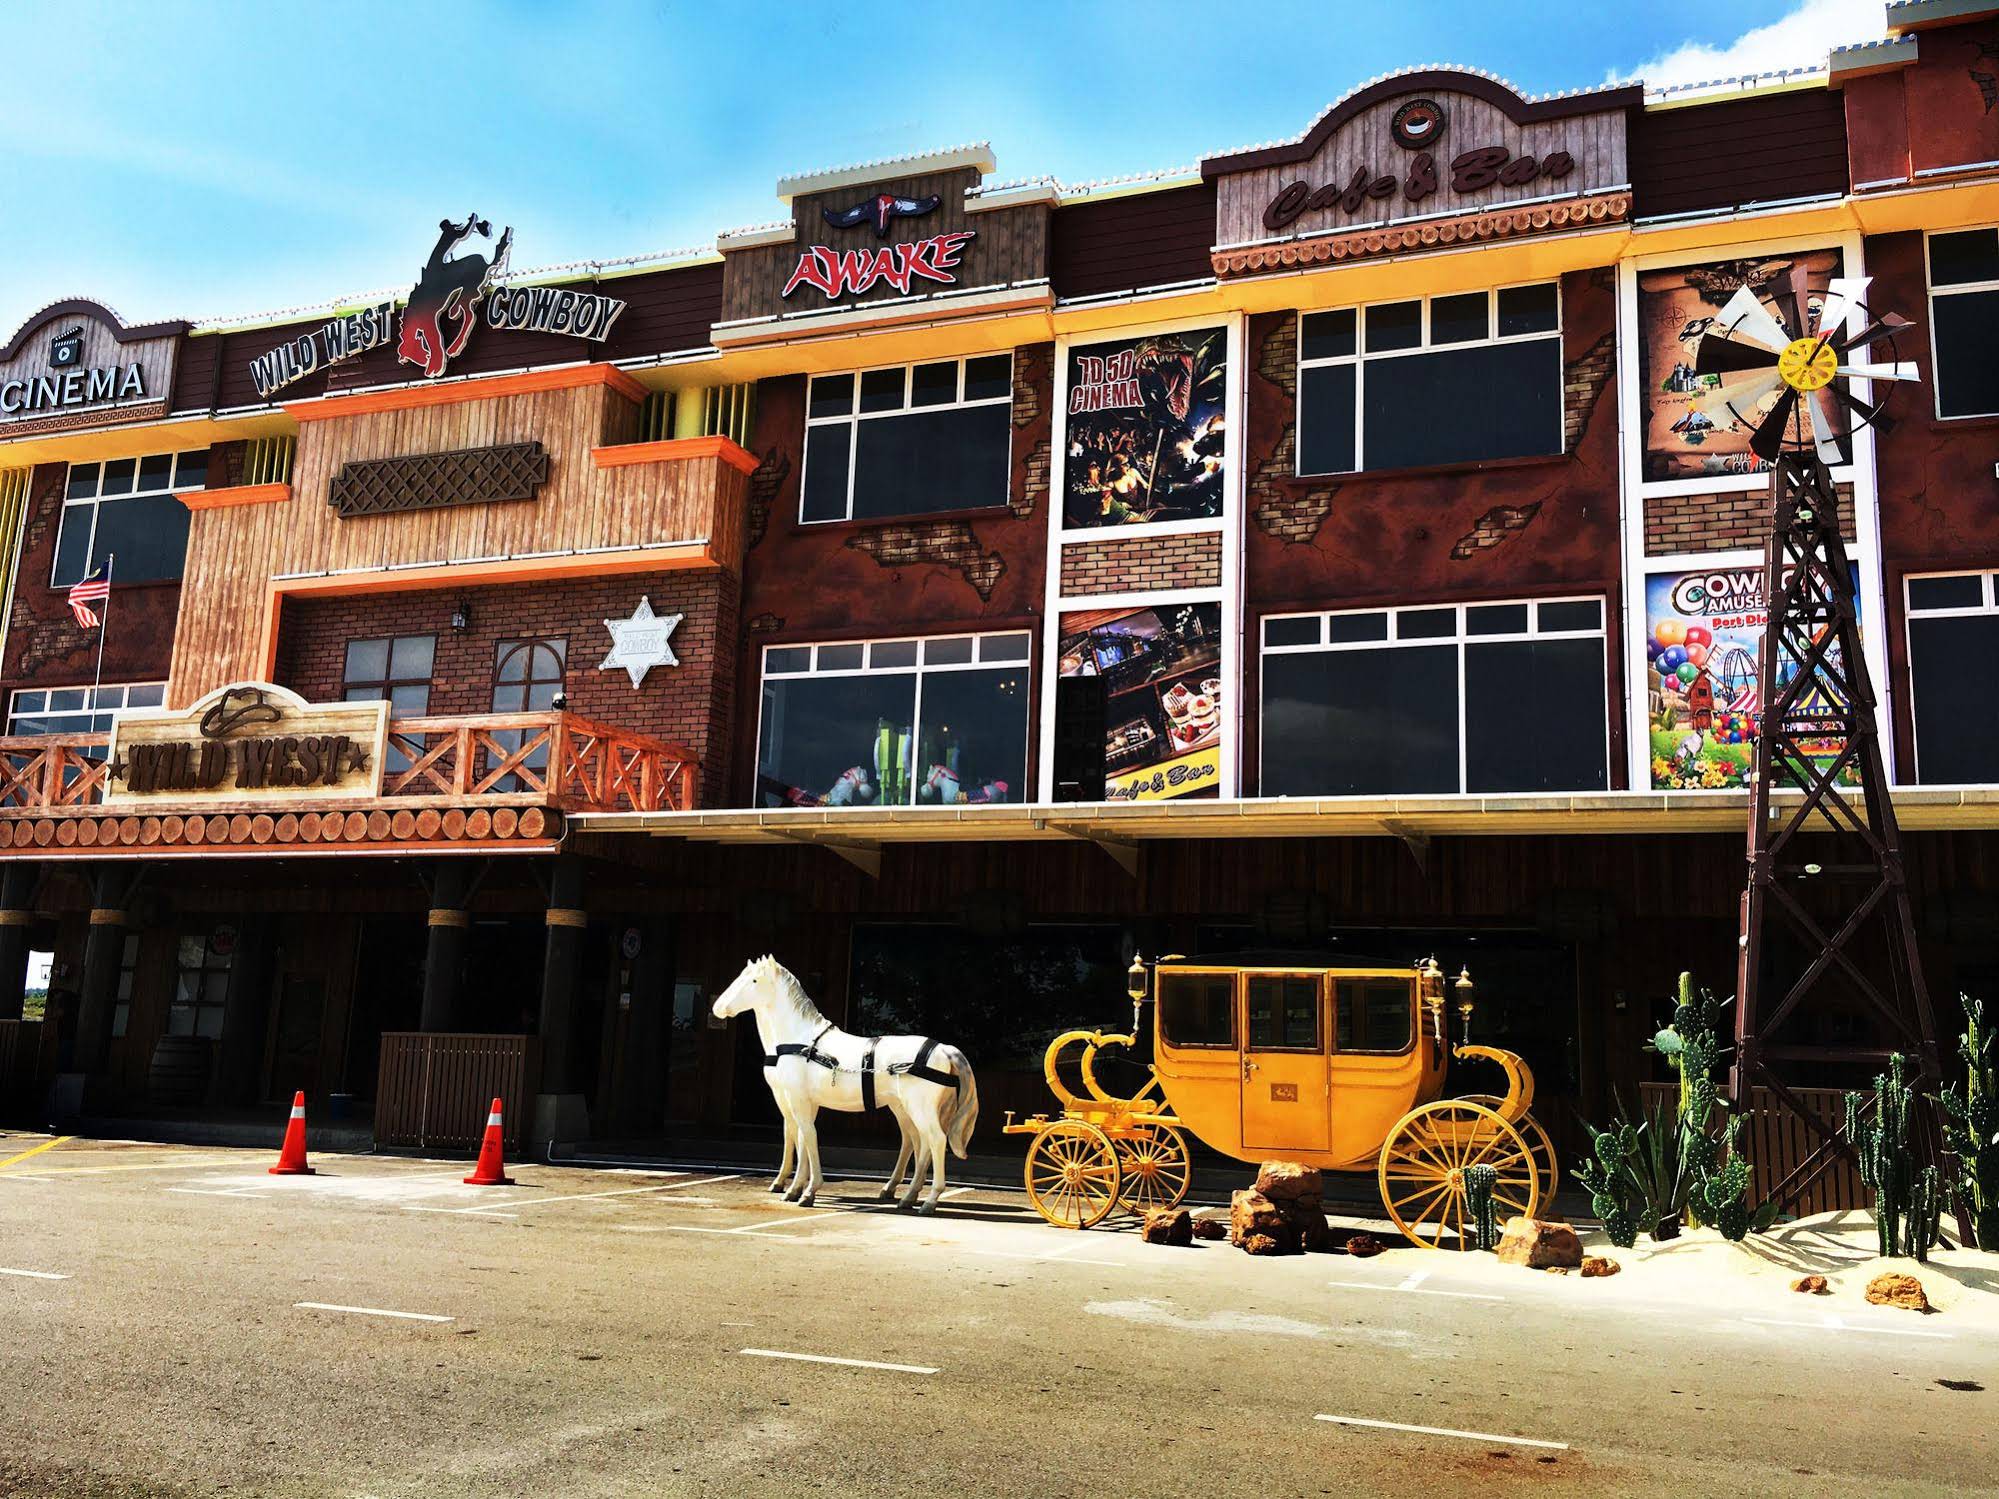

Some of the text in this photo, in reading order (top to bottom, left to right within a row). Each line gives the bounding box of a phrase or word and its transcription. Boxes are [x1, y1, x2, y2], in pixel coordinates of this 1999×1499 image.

[1262, 145, 1576, 229] Cafe & Bar
[781, 230, 977, 300] AWAKE
[249, 284, 628, 400] WILD WEST COWBOY
[1076, 349, 1135, 386] 7D 5D
[0, 363, 146, 414] CINEMA
[1069, 378, 1146, 415] CINEMA
[1712, 617, 1743, 628] Port
[127, 735, 350, 791] WILD WEST
